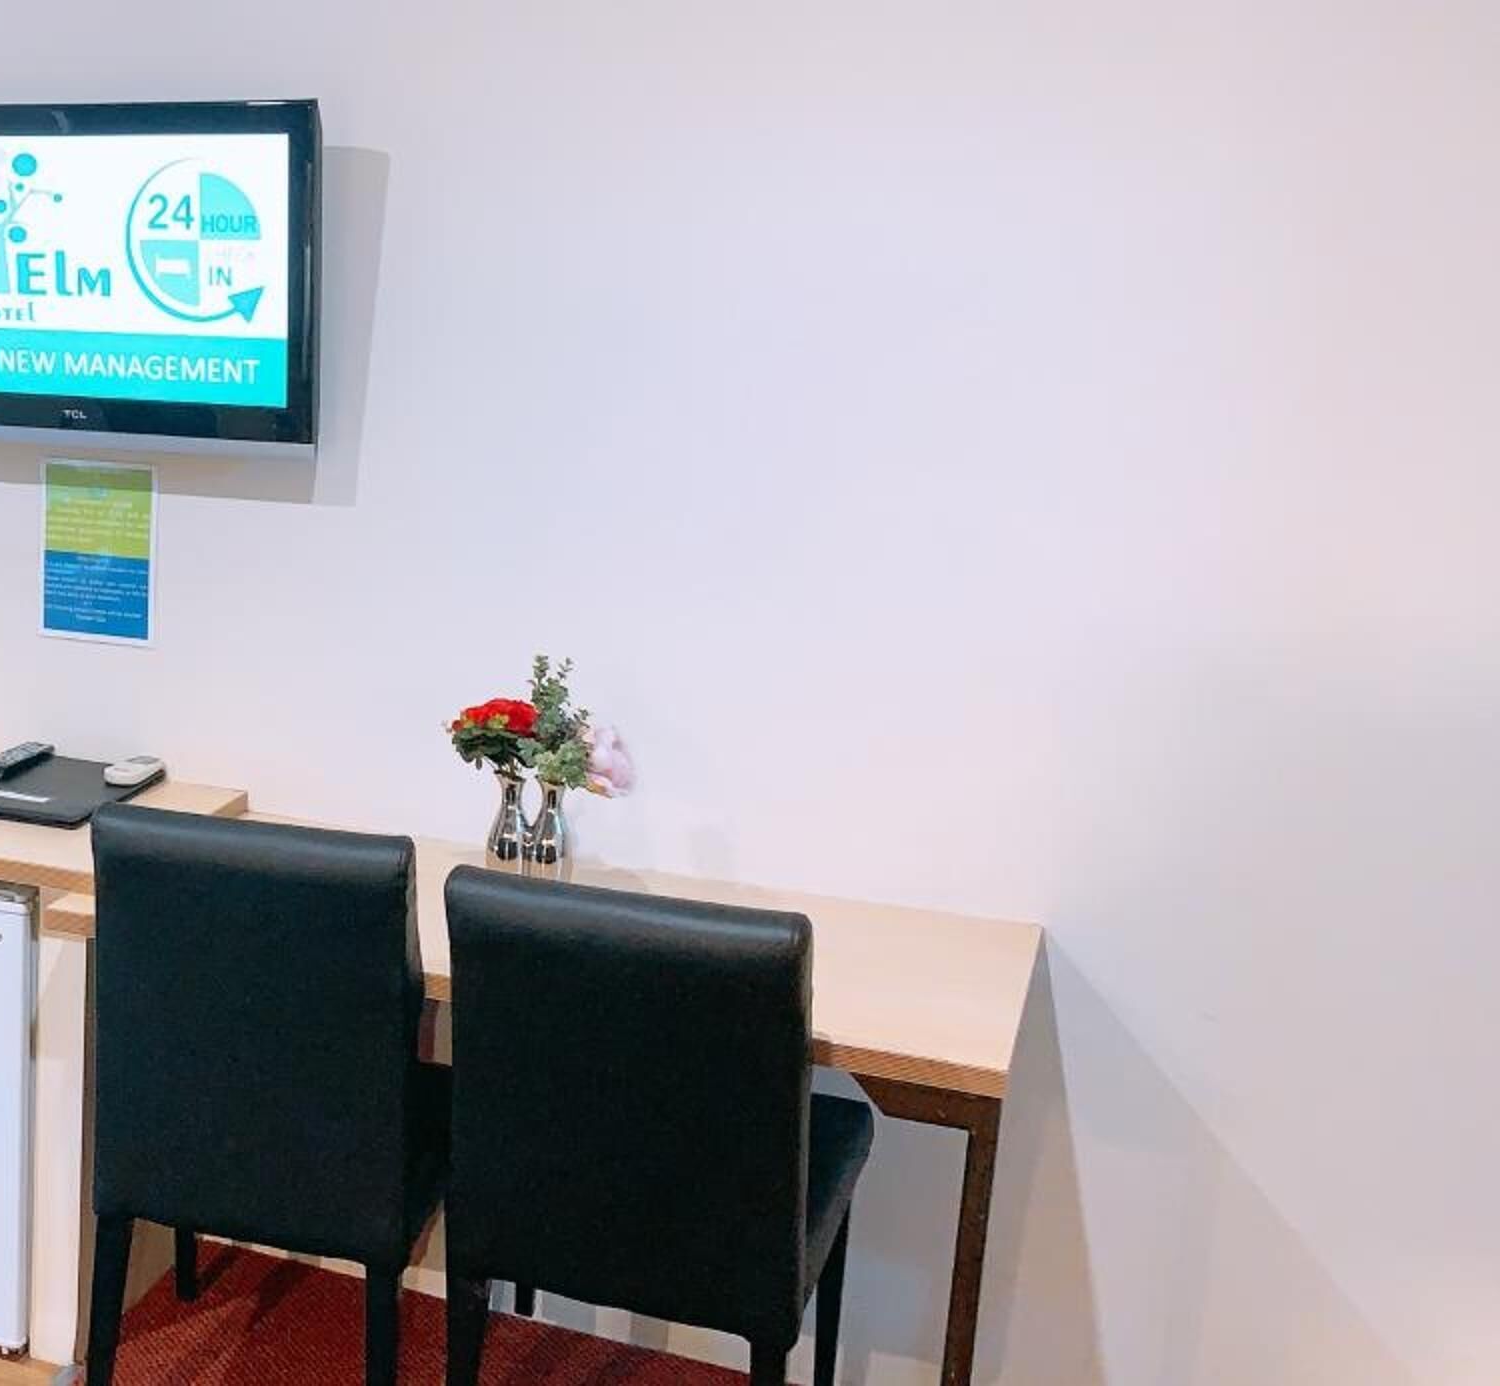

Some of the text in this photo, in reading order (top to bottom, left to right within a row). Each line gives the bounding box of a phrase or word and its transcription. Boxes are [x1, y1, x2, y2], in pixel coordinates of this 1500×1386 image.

[148, 194, 194, 230] 24
[201, 214, 257, 233] HOUR
[208, 266, 232, 286] IN
[64, 352, 260, 384] MANAGEMENT
[62, 409, 87, 419] TCL
